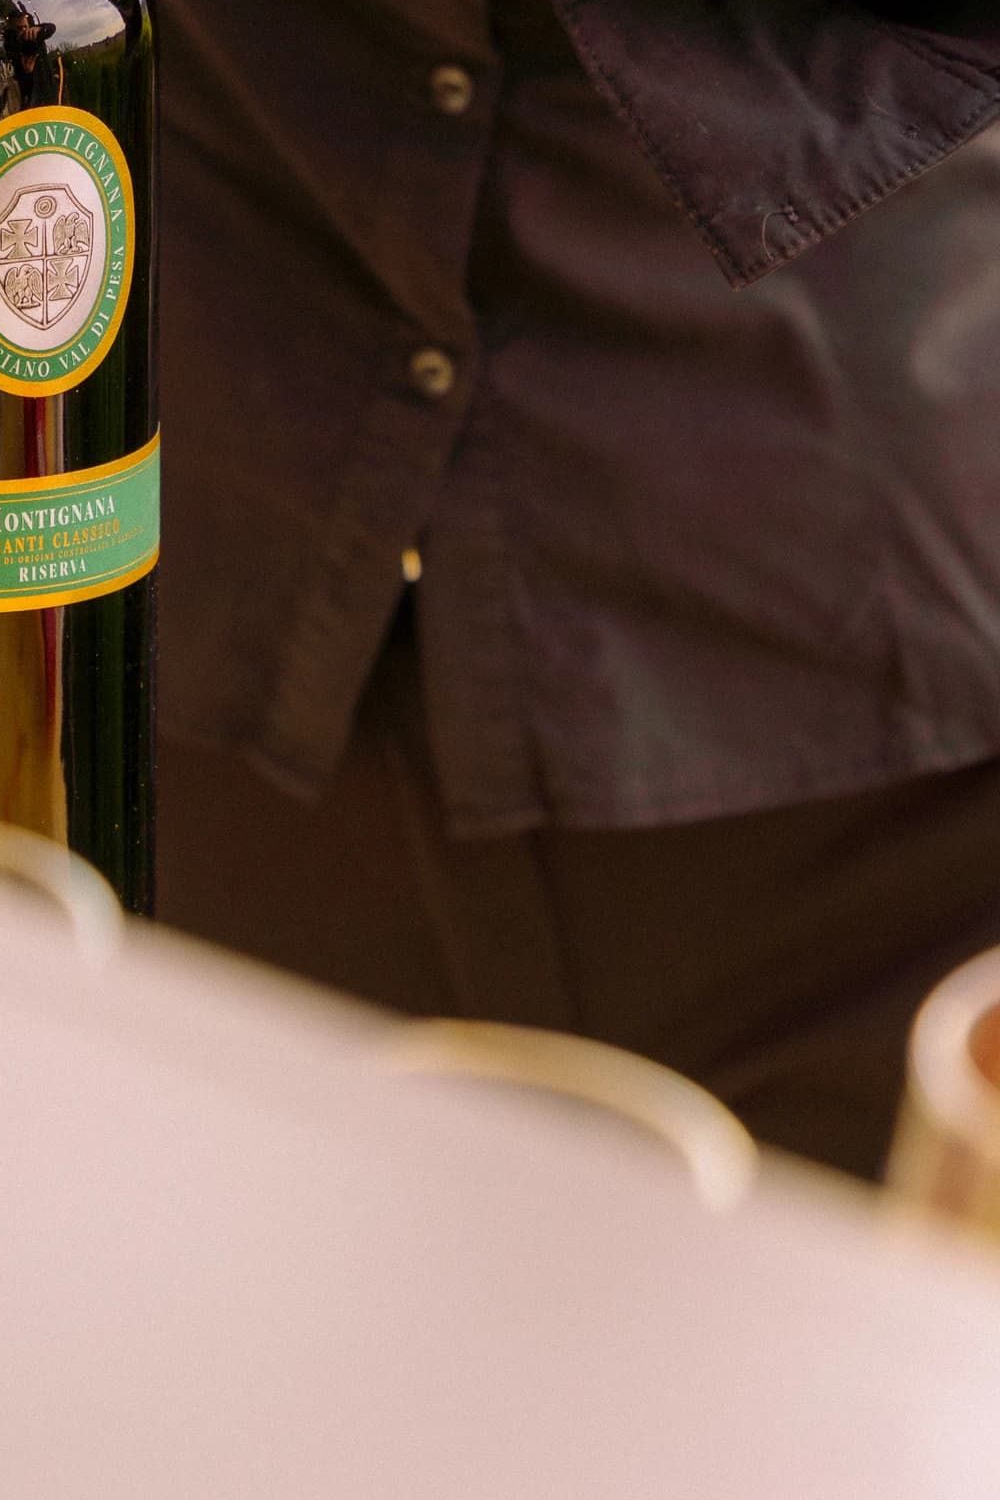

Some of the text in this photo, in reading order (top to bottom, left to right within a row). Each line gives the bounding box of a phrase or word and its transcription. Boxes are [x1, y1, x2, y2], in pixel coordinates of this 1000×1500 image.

[1, 125, 123, 222] MONTIGNANA
[59, 341, 91, 371] VAL
[90, 312, 110, 338] DI
[106, 245, 125, 300] PESA
[52, 518, 121, 549] CLASSICO
[4, 556, 14, 565] DI
[18, 552, 54, 563] ORIGINE
[19, 558, 86, 581] RISERVA
